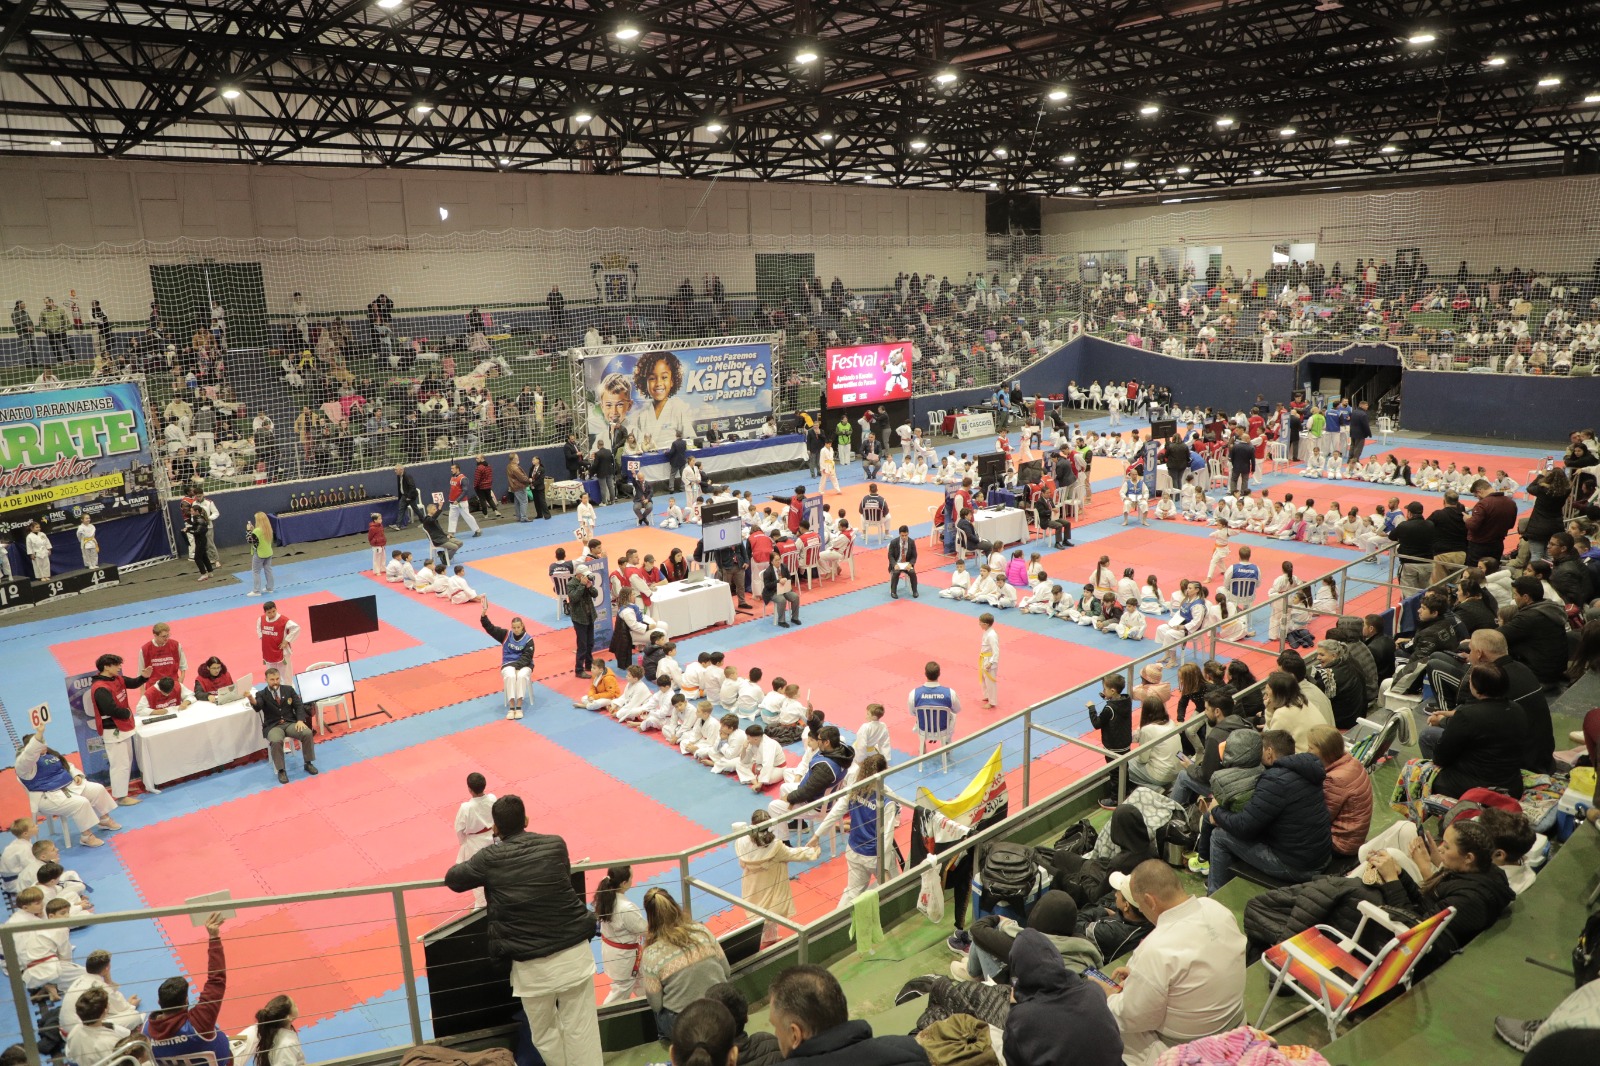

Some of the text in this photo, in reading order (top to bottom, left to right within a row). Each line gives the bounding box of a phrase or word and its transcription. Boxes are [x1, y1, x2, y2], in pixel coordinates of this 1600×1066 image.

[696, 352, 757, 364] Juntos Fazemos
[715, 361, 747, 371] Melhor
[832, 351, 878, 371] Festval
[686, 363, 766, 393] Karatê
[716, 386, 757, 400] Paraná!
[0, 397, 113, 421] NATO PARANAENSE
[745, 416, 767, 426] Sicredi
[970, 420, 992, 428] CASCAVEL
[1281, 420, 1288, 438] 5
[0, 412, 139, 471] RATE
[628, 461, 639, 470] 53
[1147, 449, 1154, 472] 6
[0, 457, 92, 487] nterestilos
[10, 497, 22, 507] DE
[24, 490, 54, 504] JUNHO
[61, 485, 78, 497] 2025
[85, 476, 122, 490] CASCAVEL
[128, 496, 149, 505] ITAIPU
[49, 511, 65, 520] FMEC
[809, 506, 820, 532] 4
[720, 529, 726, 540] 0
[91, 570, 105, 585] 4º
[0, 584, 19, 606] 1º
[47, 581, 63, 597] 3º
[321, 674, 330, 687] 0
[31, 705, 49, 727] 60
